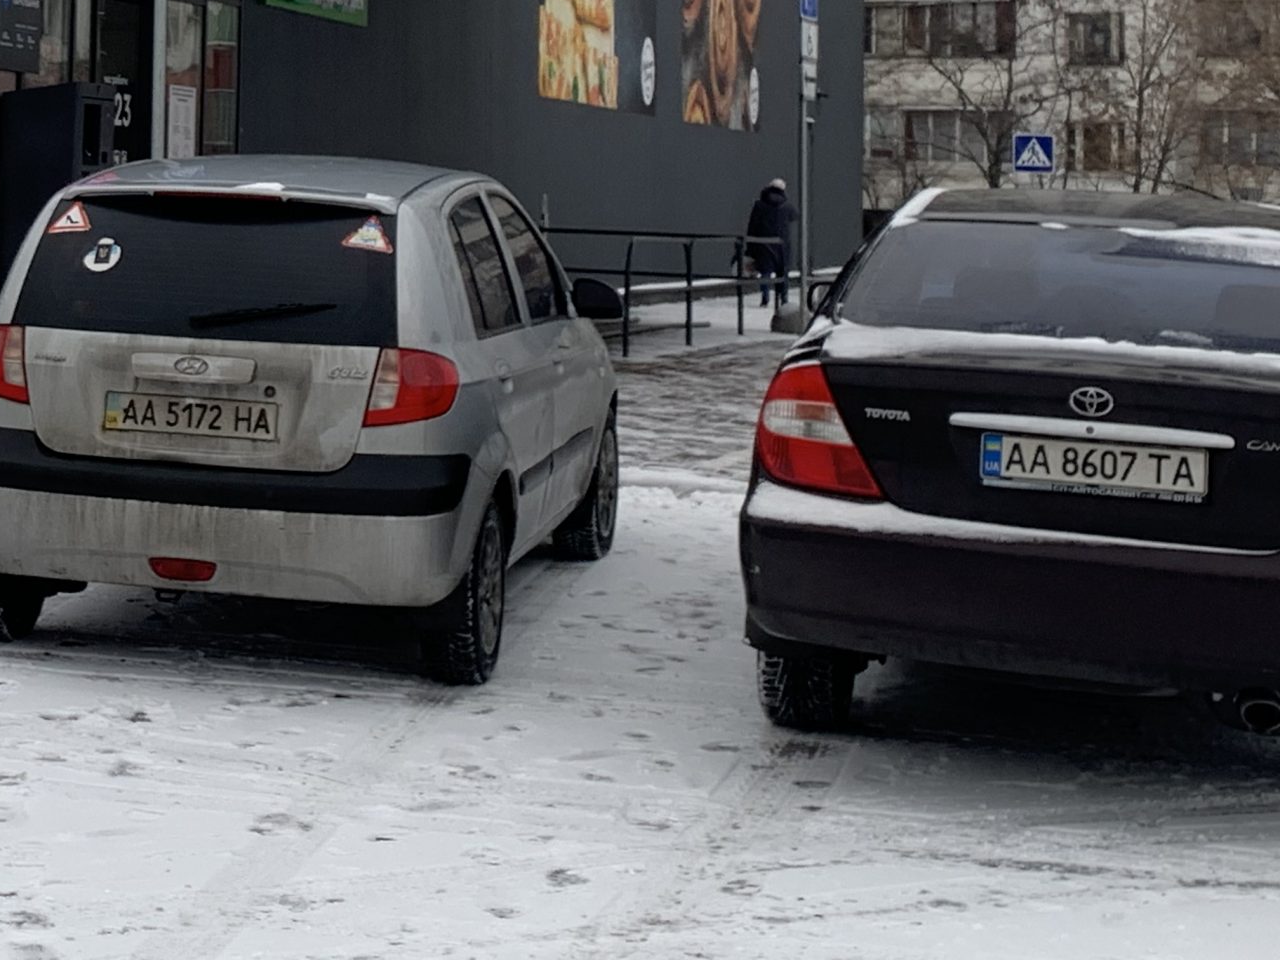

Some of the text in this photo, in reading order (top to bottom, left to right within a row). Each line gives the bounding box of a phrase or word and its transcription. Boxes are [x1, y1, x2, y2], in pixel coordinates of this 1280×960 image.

[122, 398, 156, 427] AA
[166, 401, 222, 431] 5172
[234, 405, 271, 435] HA
[864, 407, 911, 422] TOYOTA
[984, 442, 1195, 487] UA AA 8607 TA
